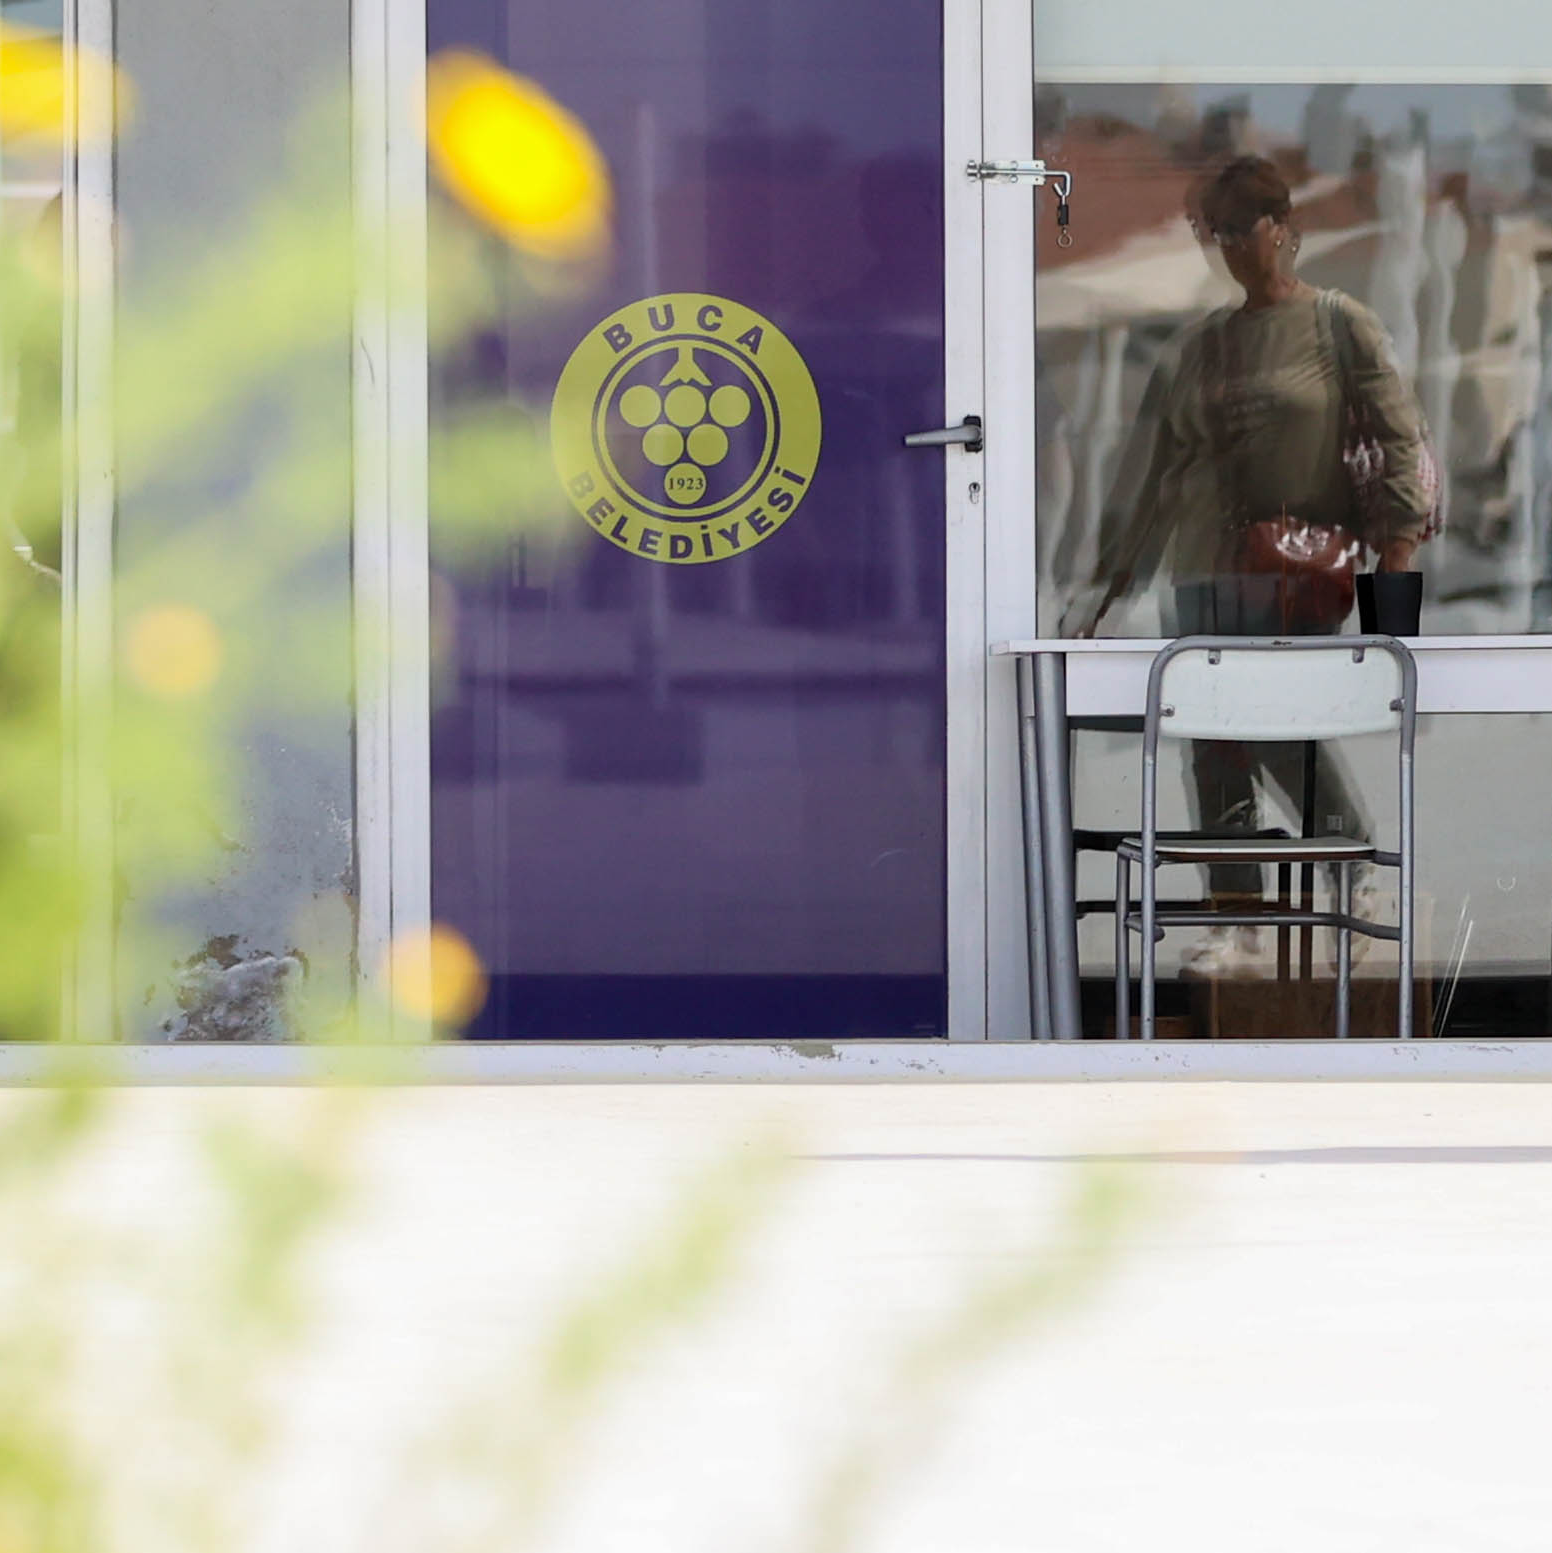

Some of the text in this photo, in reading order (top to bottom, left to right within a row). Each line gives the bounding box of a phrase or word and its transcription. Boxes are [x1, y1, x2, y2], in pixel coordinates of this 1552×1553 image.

[602, 302, 765, 356] BUCA
[667, 476, 705, 491] 1923
[567, 465, 807, 560] BELEDİYESİ
